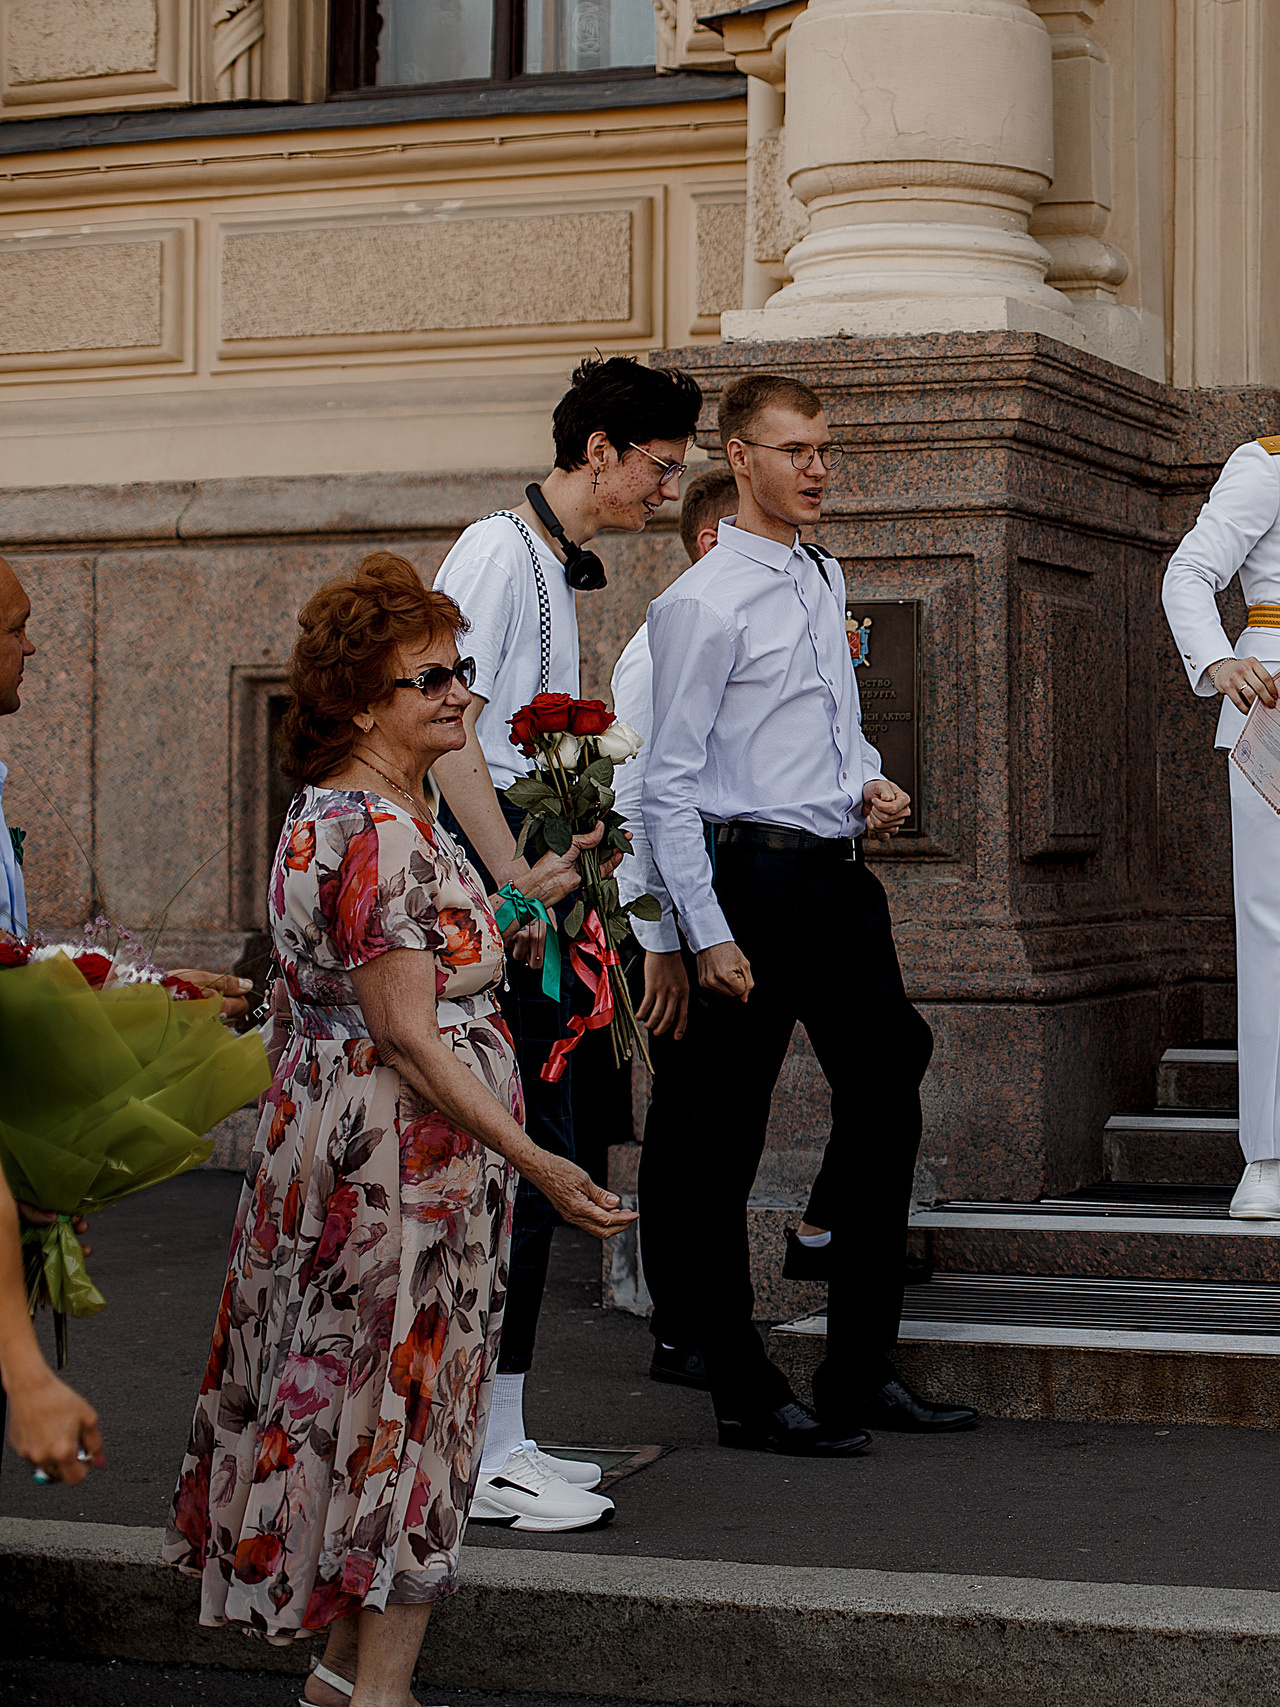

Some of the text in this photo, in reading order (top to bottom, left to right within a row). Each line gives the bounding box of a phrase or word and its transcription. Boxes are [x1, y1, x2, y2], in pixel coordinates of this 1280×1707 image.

[859, 679, 891, 687] ЬСТВО
[860, 690, 896, 698] РБУРГА
[862, 723, 888, 731] КОГО
